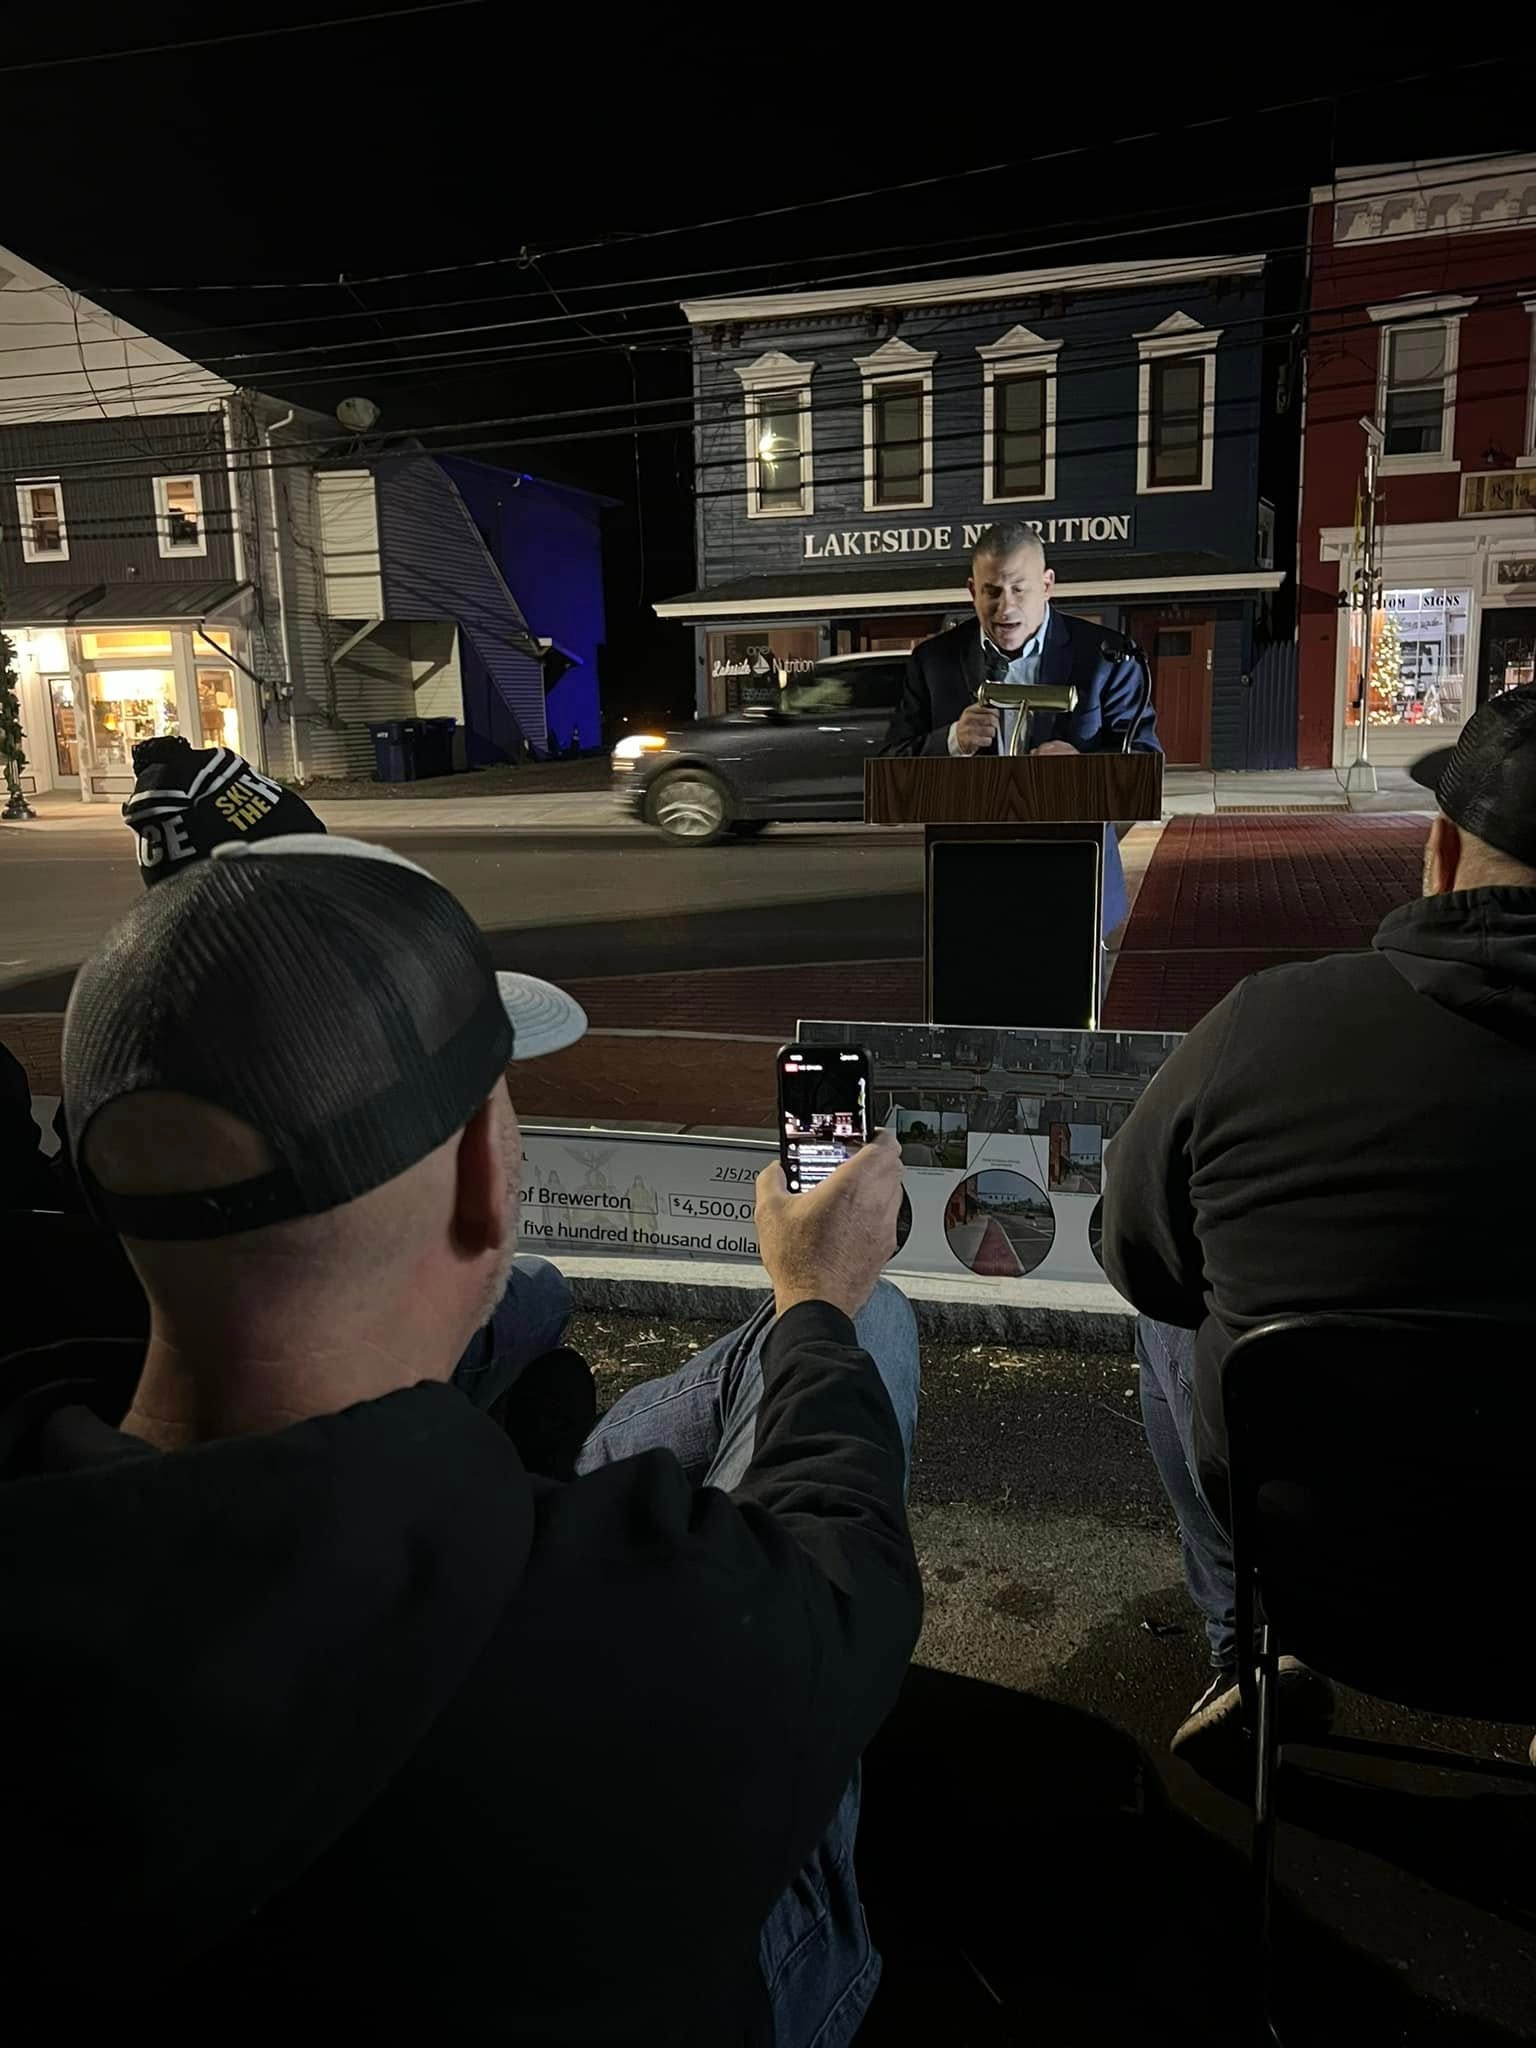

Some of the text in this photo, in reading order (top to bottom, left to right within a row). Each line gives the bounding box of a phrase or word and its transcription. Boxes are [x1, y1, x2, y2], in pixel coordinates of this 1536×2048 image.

[803, 514, 1132, 559] LAKESIDE NRITION
[1423, 595, 1461, 607] SIGNS
[214, 781, 254, 816] SKI
[226, 794, 273, 833] THE
[538, 1187, 632, 1210] Brewerton
[673, 1197, 755, 1221] $4,500,0
[523, 1220, 554, 1236] five
[558, 1222, 628, 1242] hundred
[632, 1228, 712, 1250] thousand
